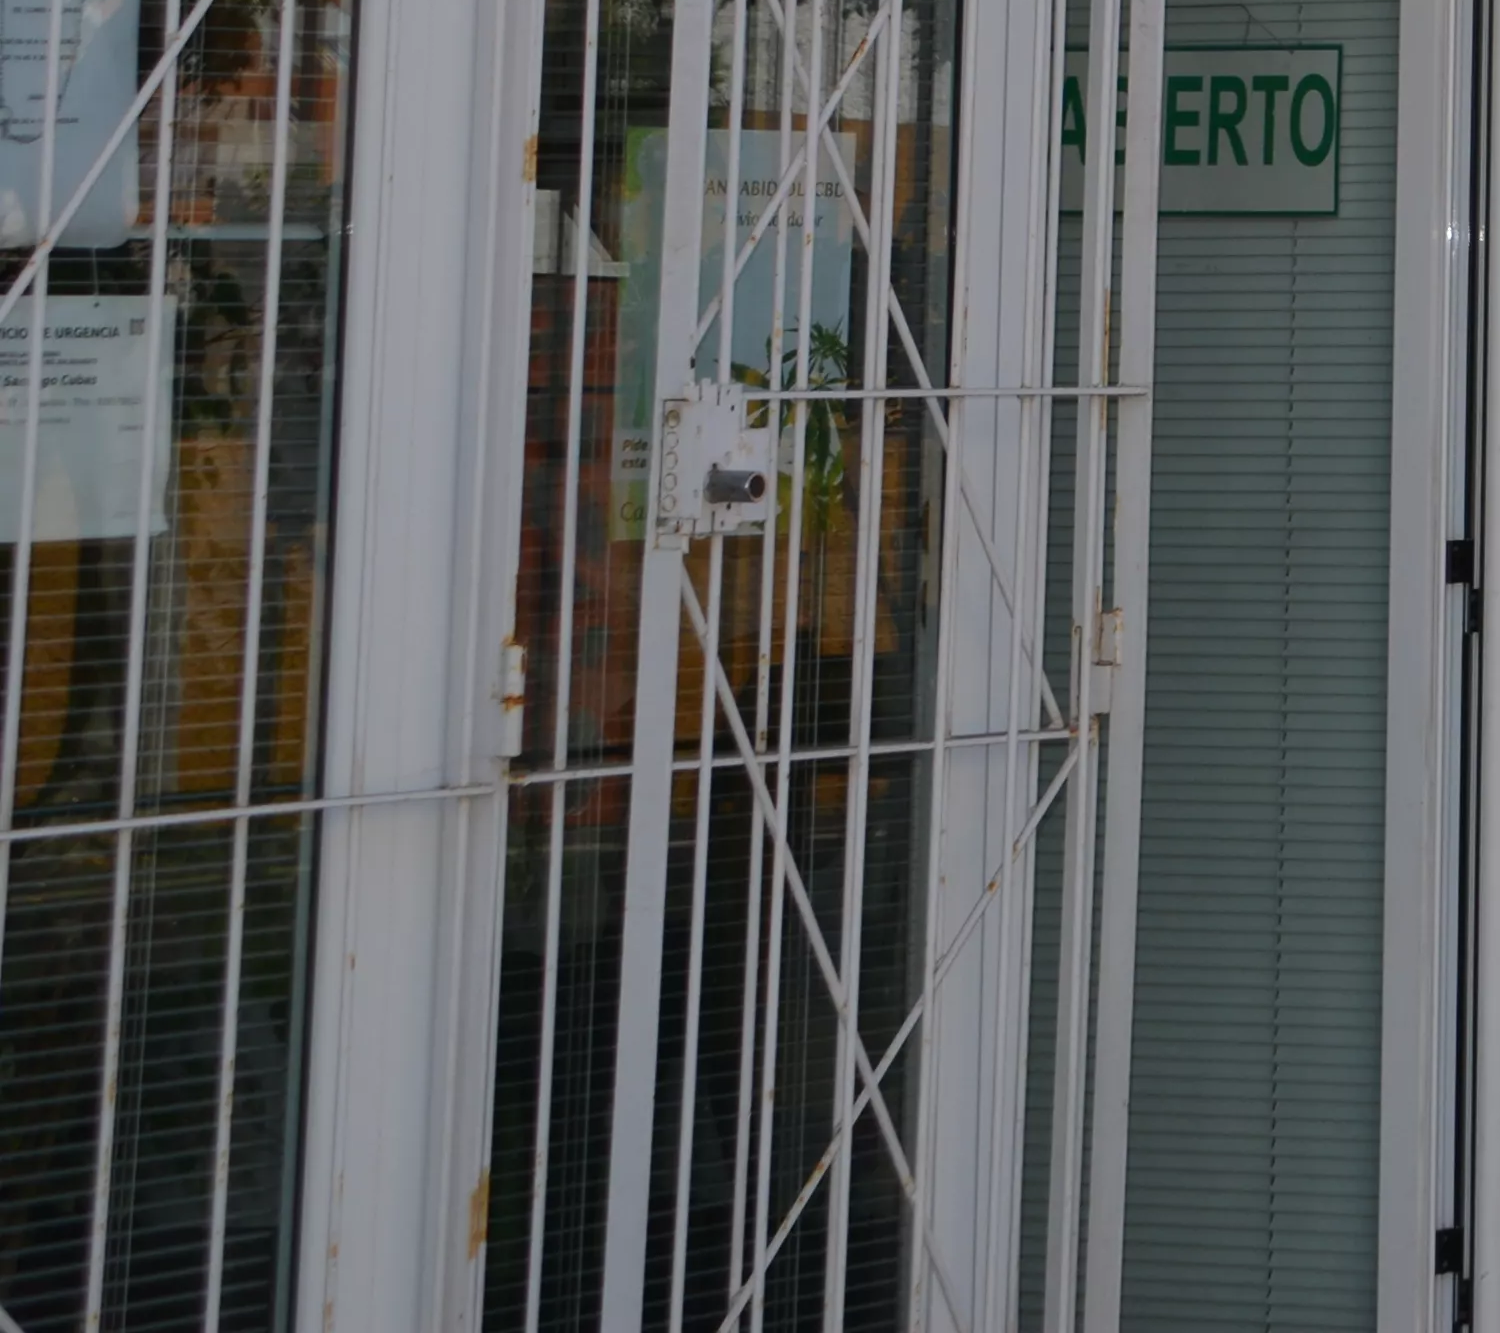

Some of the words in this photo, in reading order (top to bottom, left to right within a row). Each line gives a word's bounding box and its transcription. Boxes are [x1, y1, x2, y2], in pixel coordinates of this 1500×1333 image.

[1061, 72, 1335, 167] AERTO
[55, 326, 121, 340] URGENCIA
[61, 374, 98, 386] Cubas
[622, 437, 648, 451] Pide
